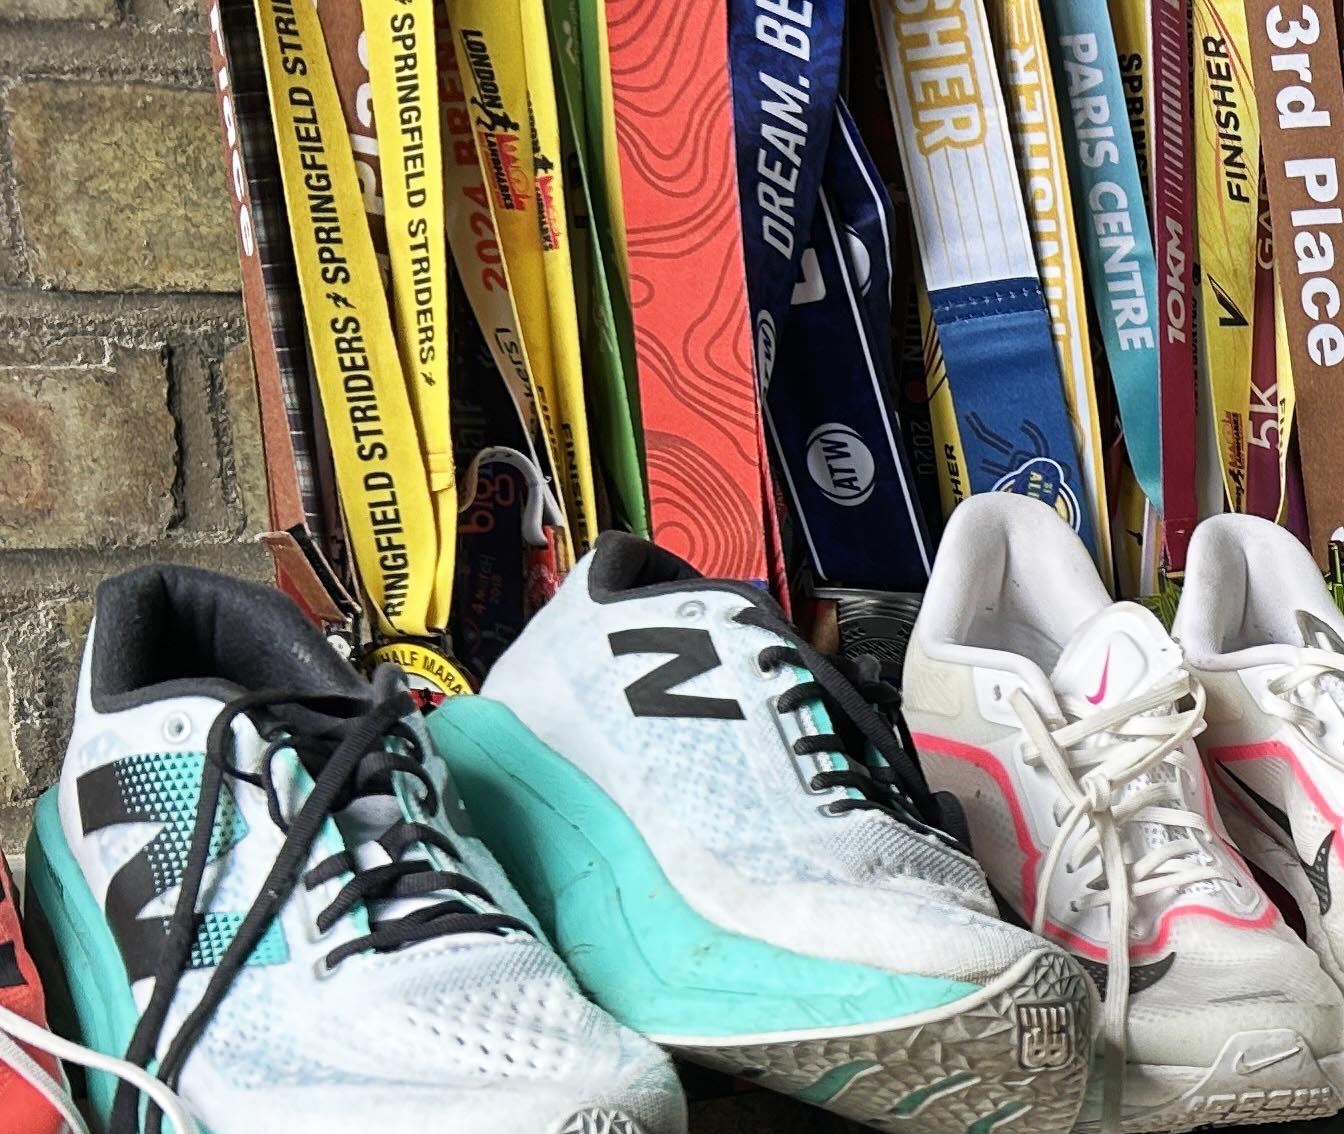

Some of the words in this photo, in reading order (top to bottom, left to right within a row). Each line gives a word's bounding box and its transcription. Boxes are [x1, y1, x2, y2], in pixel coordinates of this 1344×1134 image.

[270, 0, 307, 77] STRI
[461, 28, 504, 112] LONDON
[1057, 32, 1121, 170] PARIS
[1265, 4, 1332, 130] 3rd
[390, 13, 427, 209] SPRINGFIELD
[756, 72, 811, 260] DREAM.
[1202, 35, 1250, 203] FINISHER
[288, 87, 350, 285] SPRINGFIELD
[407, 217, 436, 365] STRIDERS
[1088, 181, 1155, 351] CENTRE
[1165, 216, 1187, 344] 10KM
[330, 316, 388, 460] STRIDERS
[1248, 383, 1279, 450] 5K
[819, 438, 861, 492] ATW
[363, 471, 411, 621] RINGFIELD
[380, 650, 419, 670] HALF
[422, 653, 468, 696] MARA
